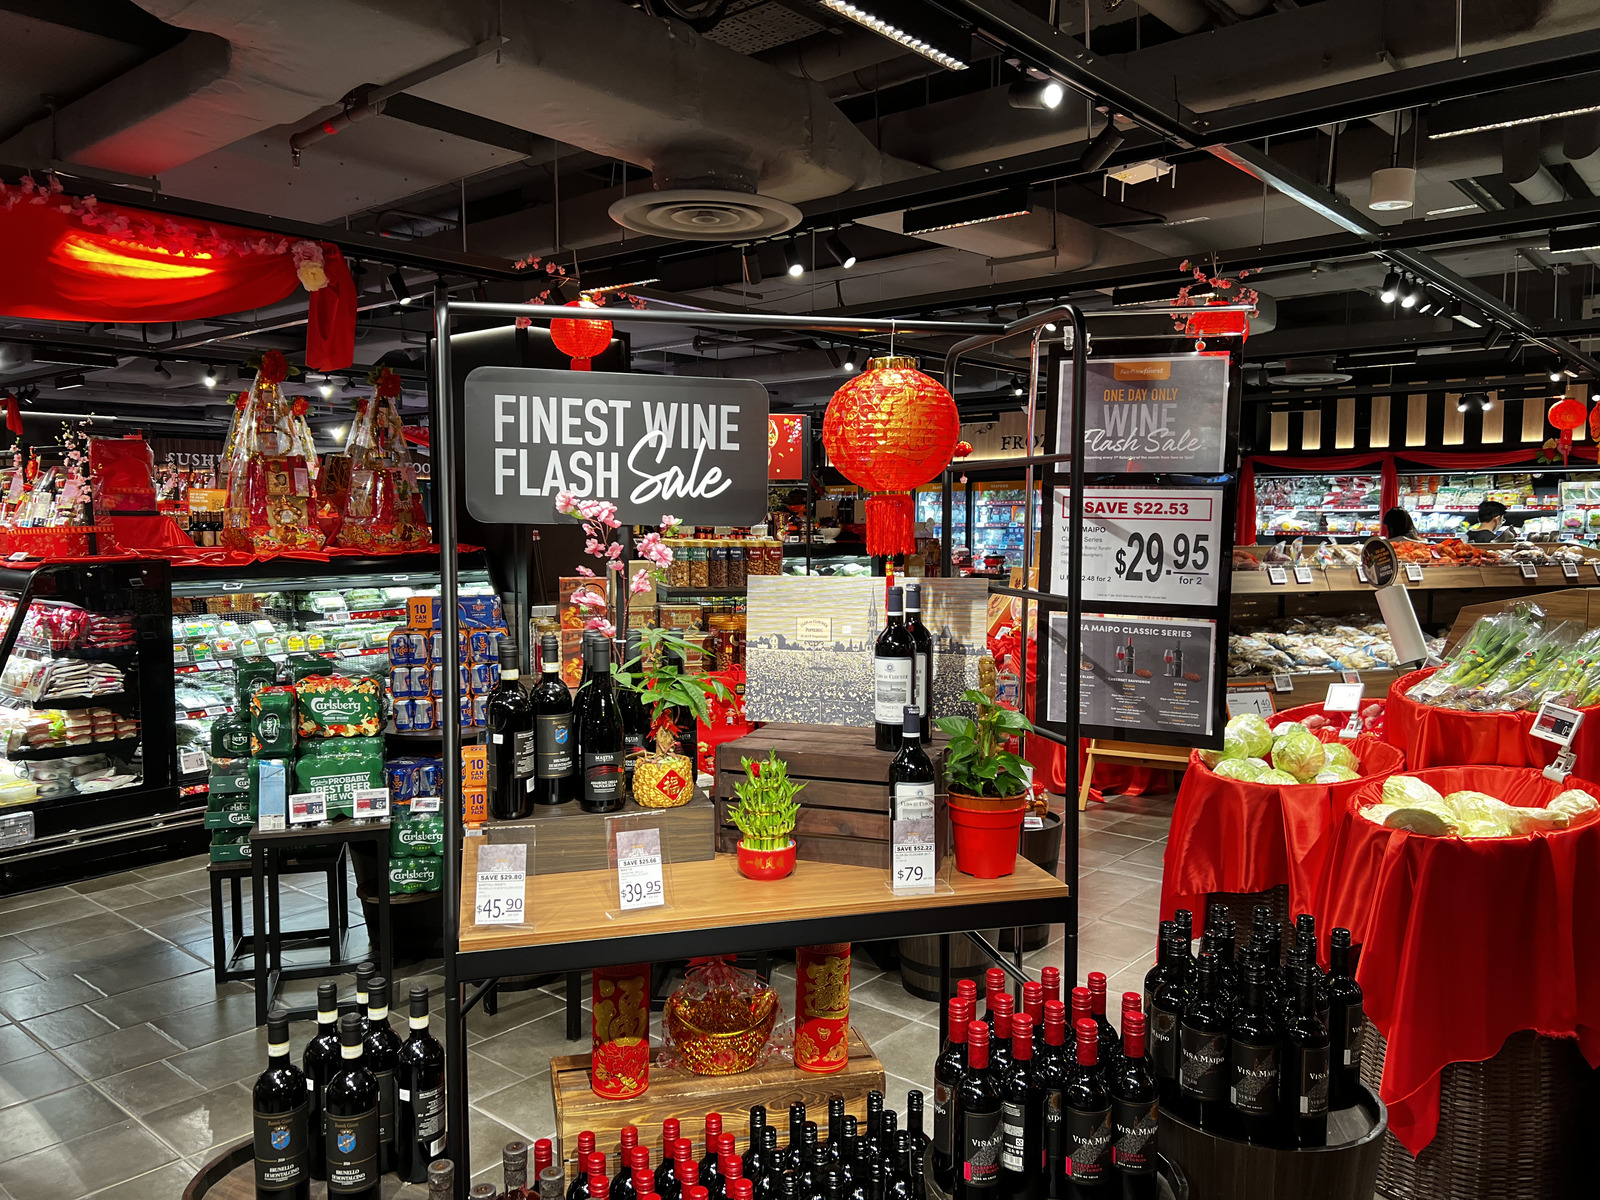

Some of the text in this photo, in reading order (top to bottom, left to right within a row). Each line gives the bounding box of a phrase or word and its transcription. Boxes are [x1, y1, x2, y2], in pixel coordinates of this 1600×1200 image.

[1104, 388, 1178, 402] ONE DAY ONLY
[494, 394, 740, 450] FINEST WINE
[1103, 403, 1178, 437] WINE
[1084, 427, 1203, 452] Flash Sale
[494, 430, 733, 504] FLASH Sale
[1084, 502, 1189, 516] SAVE $22.53
[1114, 532, 1210, 582] $29.95
[1179, 576, 1202, 585] for 2
[414, 604, 427, 614] 10
[1091, 624, 1120, 633] MAIPO
[1122, 626, 1159, 636] CLASSIC
[1161, 629, 1192, 638] SERIES
[310, 697, 361, 714] Carlsberg
[470, 759, 484, 770] 10
[329, 774, 370, 785] PROBABLY
[663, 776, 681, 795] 福
[315, 782, 370, 794] BEST BEER
[470, 794, 484, 804] 10
[399, 829, 444, 845] Carlsberg
[390, 867, 435, 884] Carlsberg
[897, 866, 924, 881] $79
[621, 881, 662, 903] $39.95
[477, 898, 523, 918] $45.90
[594, 975, 648, 1048] 福
[1236, 1066, 1277, 1078] VIÑA MAIP
[1117, 1124, 1159, 1136] VIÑA MAIP
[972, 1138, 992, 1147] VIÑA
[1072, 1134, 1092, 1146] VIÑA
[269, 1164, 294, 1172] BRUNELLO
